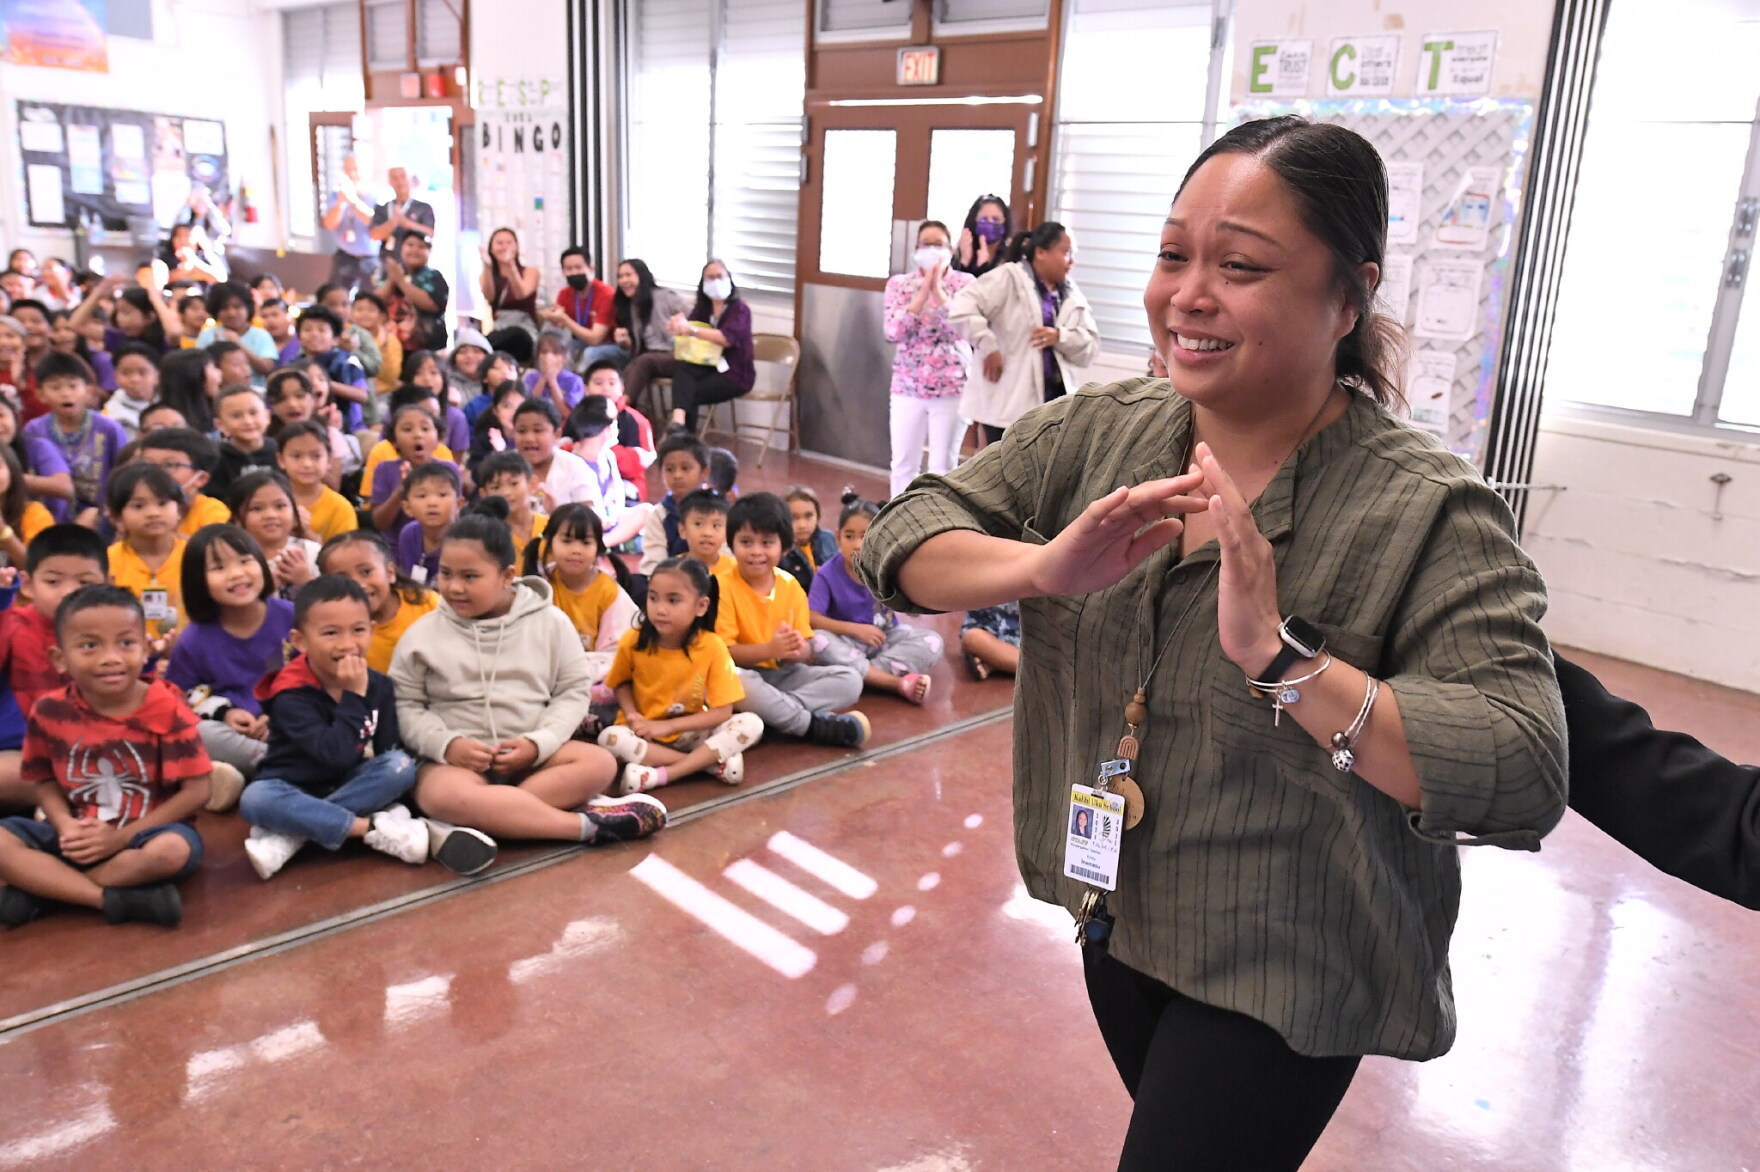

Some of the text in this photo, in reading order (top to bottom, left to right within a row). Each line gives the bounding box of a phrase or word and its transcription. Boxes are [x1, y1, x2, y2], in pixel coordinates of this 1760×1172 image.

[904, 52, 936, 80] EXIT
[1250, 45, 1278, 93] E
[1330, 43, 1357, 91] C
[1423, 41, 1454, 91] T
[482, 121, 562, 153] BINGO
